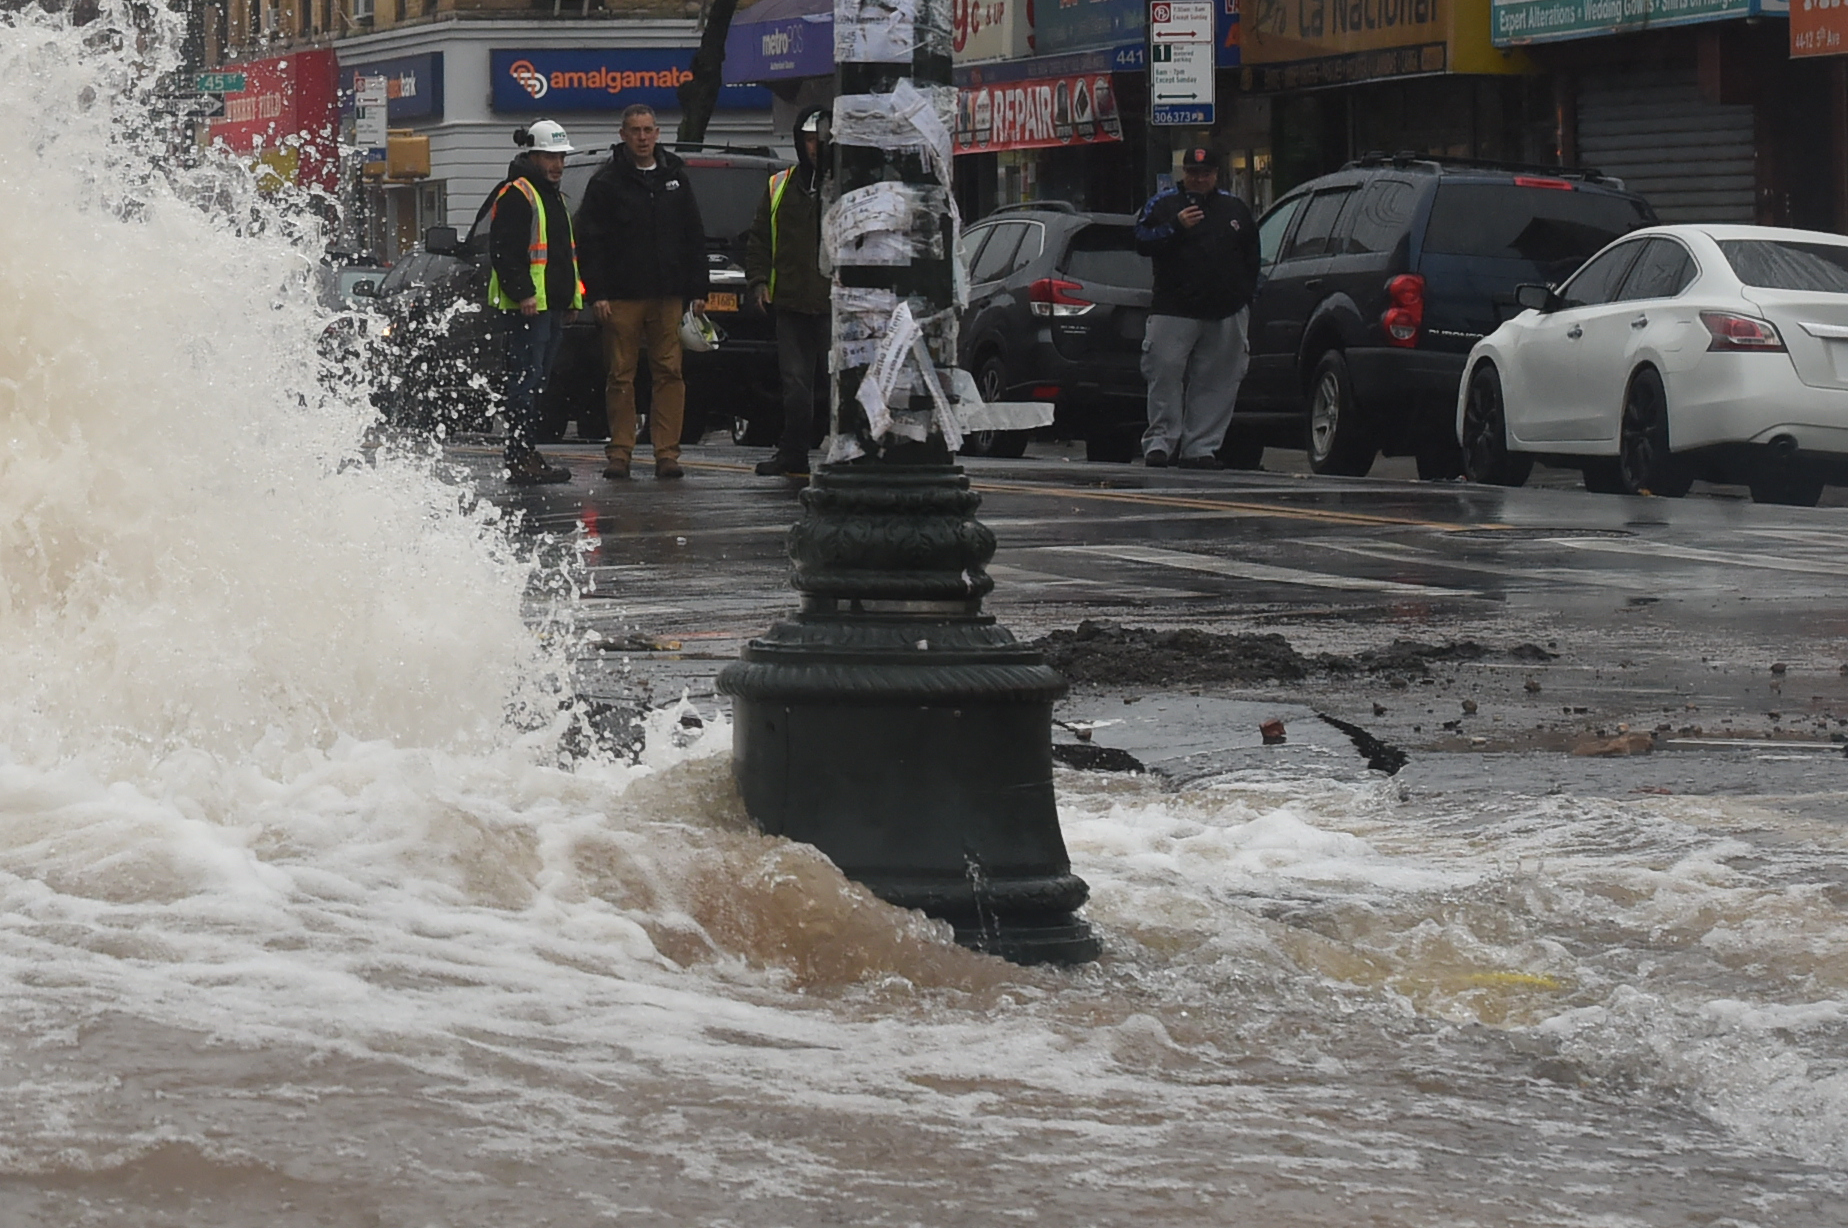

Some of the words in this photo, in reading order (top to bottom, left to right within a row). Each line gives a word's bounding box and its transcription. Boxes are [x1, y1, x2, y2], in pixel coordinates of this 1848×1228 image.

[993, 1, 1004, 26] UP
[1499, 8, 1527, 34] Expert
[1527, 5, 1576, 29] Alterations
[1826, 29, 1841, 47] Ave
[1158, 44, 1166, 61] 1
[205, 75, 225, 89] 45
[549, 67, 694, 94] amalgamate
[1176, 76, 1198, 84] Sunday
[992, 84, 1056, 143] REPAIR
[1154, 112, 1191, 123] 306373
